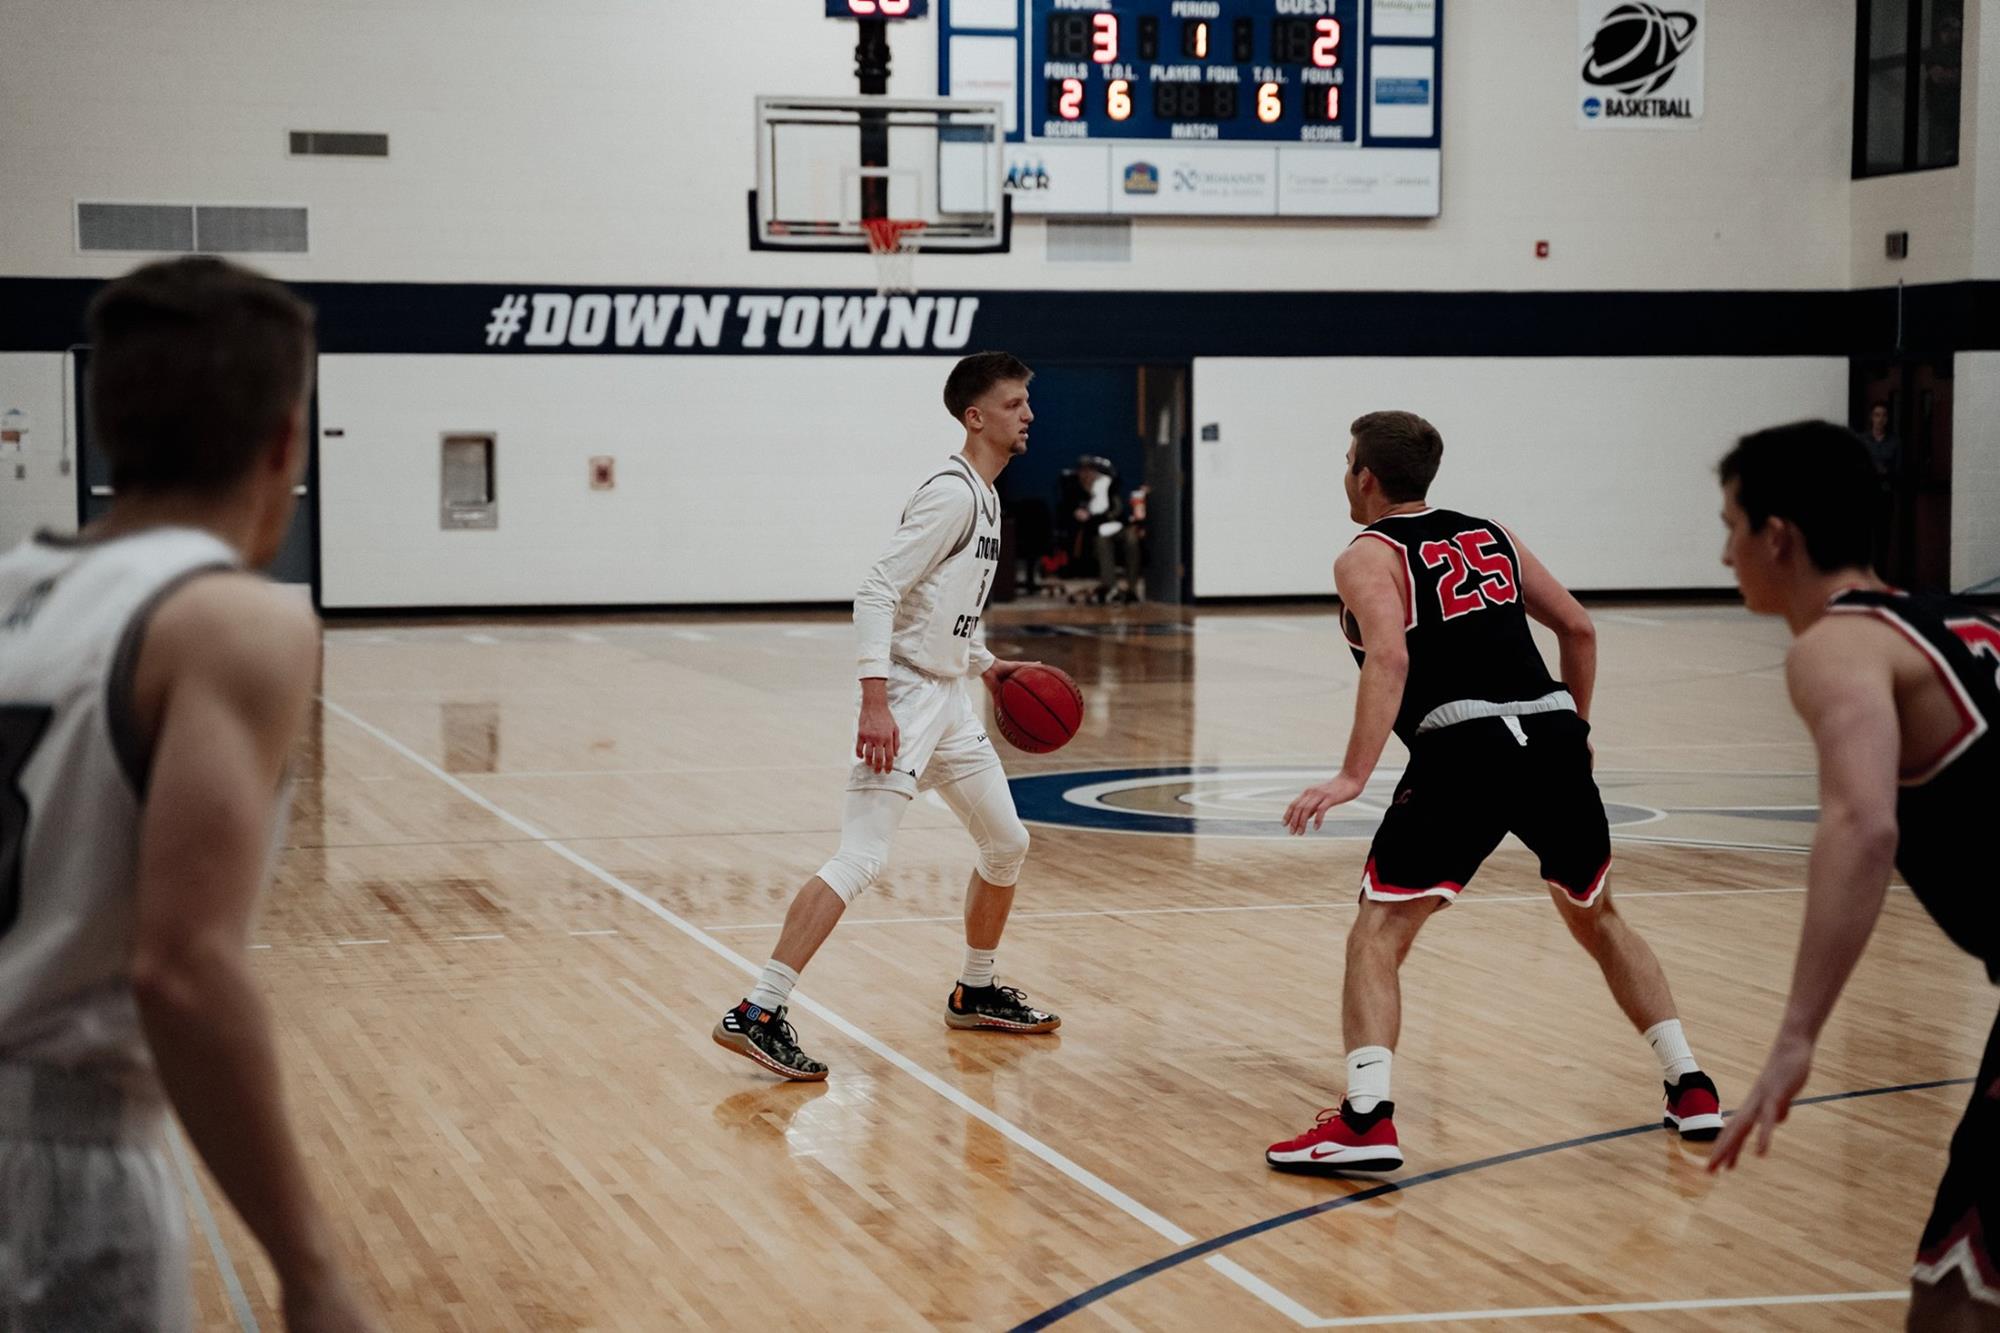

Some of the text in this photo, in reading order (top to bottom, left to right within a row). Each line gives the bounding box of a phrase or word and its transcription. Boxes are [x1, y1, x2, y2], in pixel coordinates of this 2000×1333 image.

[1172, 1, 1219, 18] PERIOD
[1275, 0, 1336, 15] GUEST
[1092, 13, 1118, 63] 3
[1195, 22, 1207, 58] 1
[1312, 18, 1341, 67] 2
[1044, 62, 1088, 79] FOULS
[1150, 65, 1240, 82] PLAYER FOUL
[1301, 67, 1344, 84] FOULS
[1059, 78, 1083, 119] 2
[1107, 80, 1131, 120] 6
[1257, 83, 1281, 123] 6
[1327, 86, 1339, 120] 1
[1605, 98, 1692, 118] BASKETBALL
[1044, 121, 1088, 138] SCORE
[1172, 123, 1218, 139] MATCH
[1301, 125, 1344, 142] SCORE
[1419, 528, 1518, 622] 25
